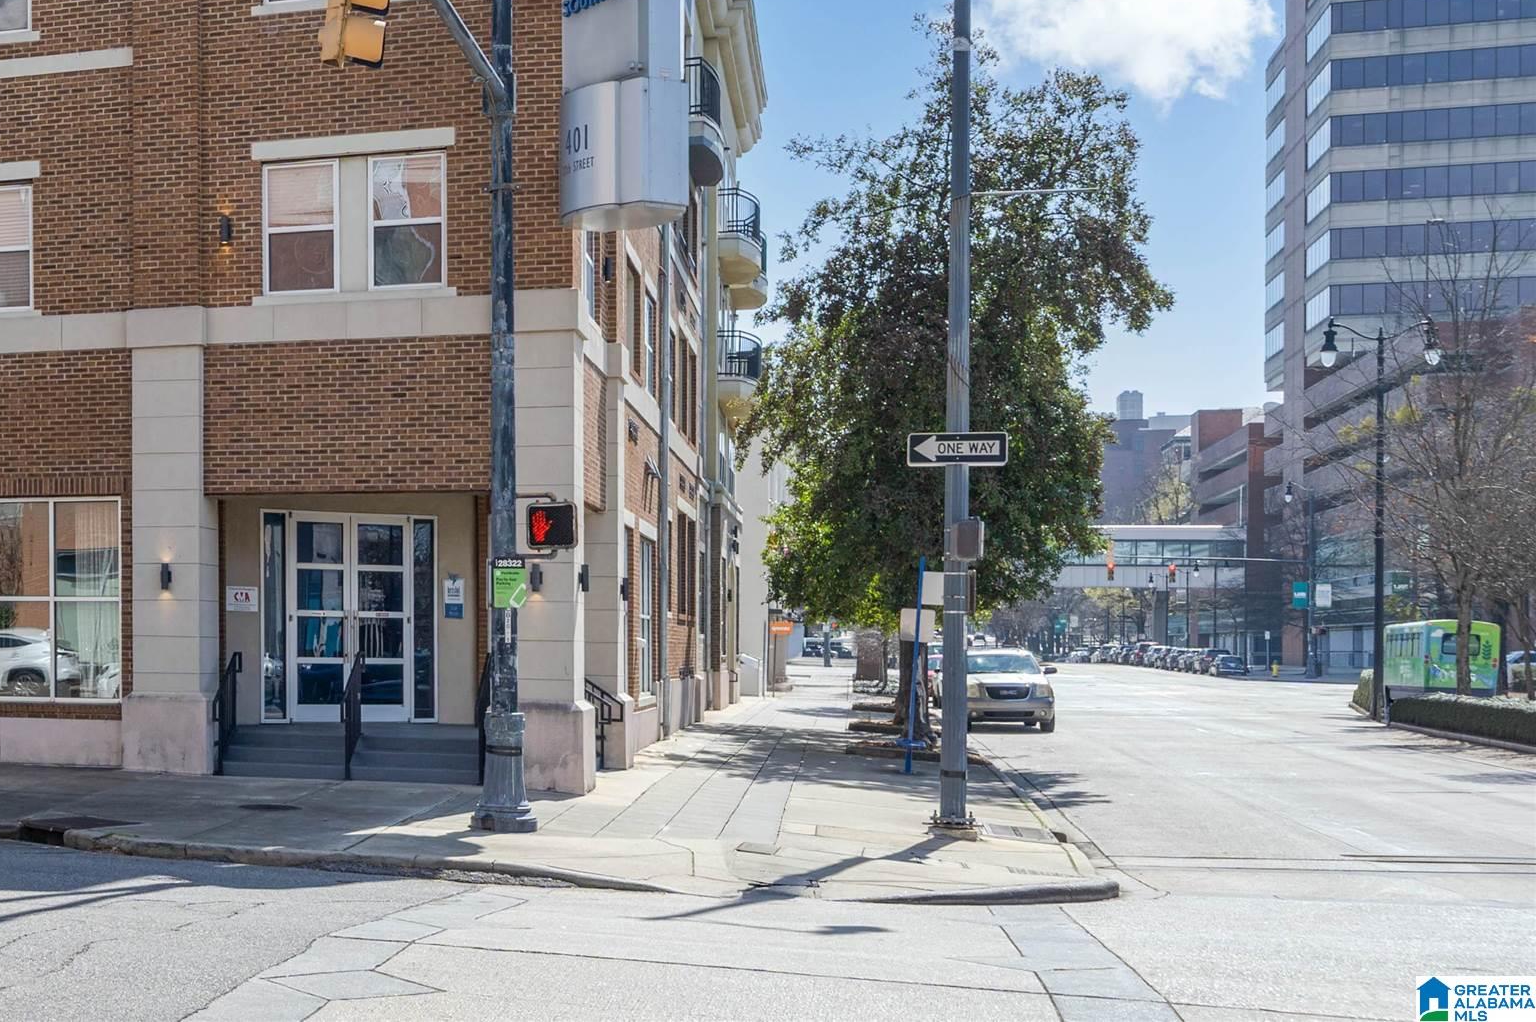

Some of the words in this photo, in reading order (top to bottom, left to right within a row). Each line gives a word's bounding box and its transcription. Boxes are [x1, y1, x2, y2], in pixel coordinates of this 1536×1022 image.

[566, 124, 588, 155] 401
[573, 156, 595, 172] STREET
[937, 442, 963, 454] ONE
[968, 442, 996, 454] WAY
